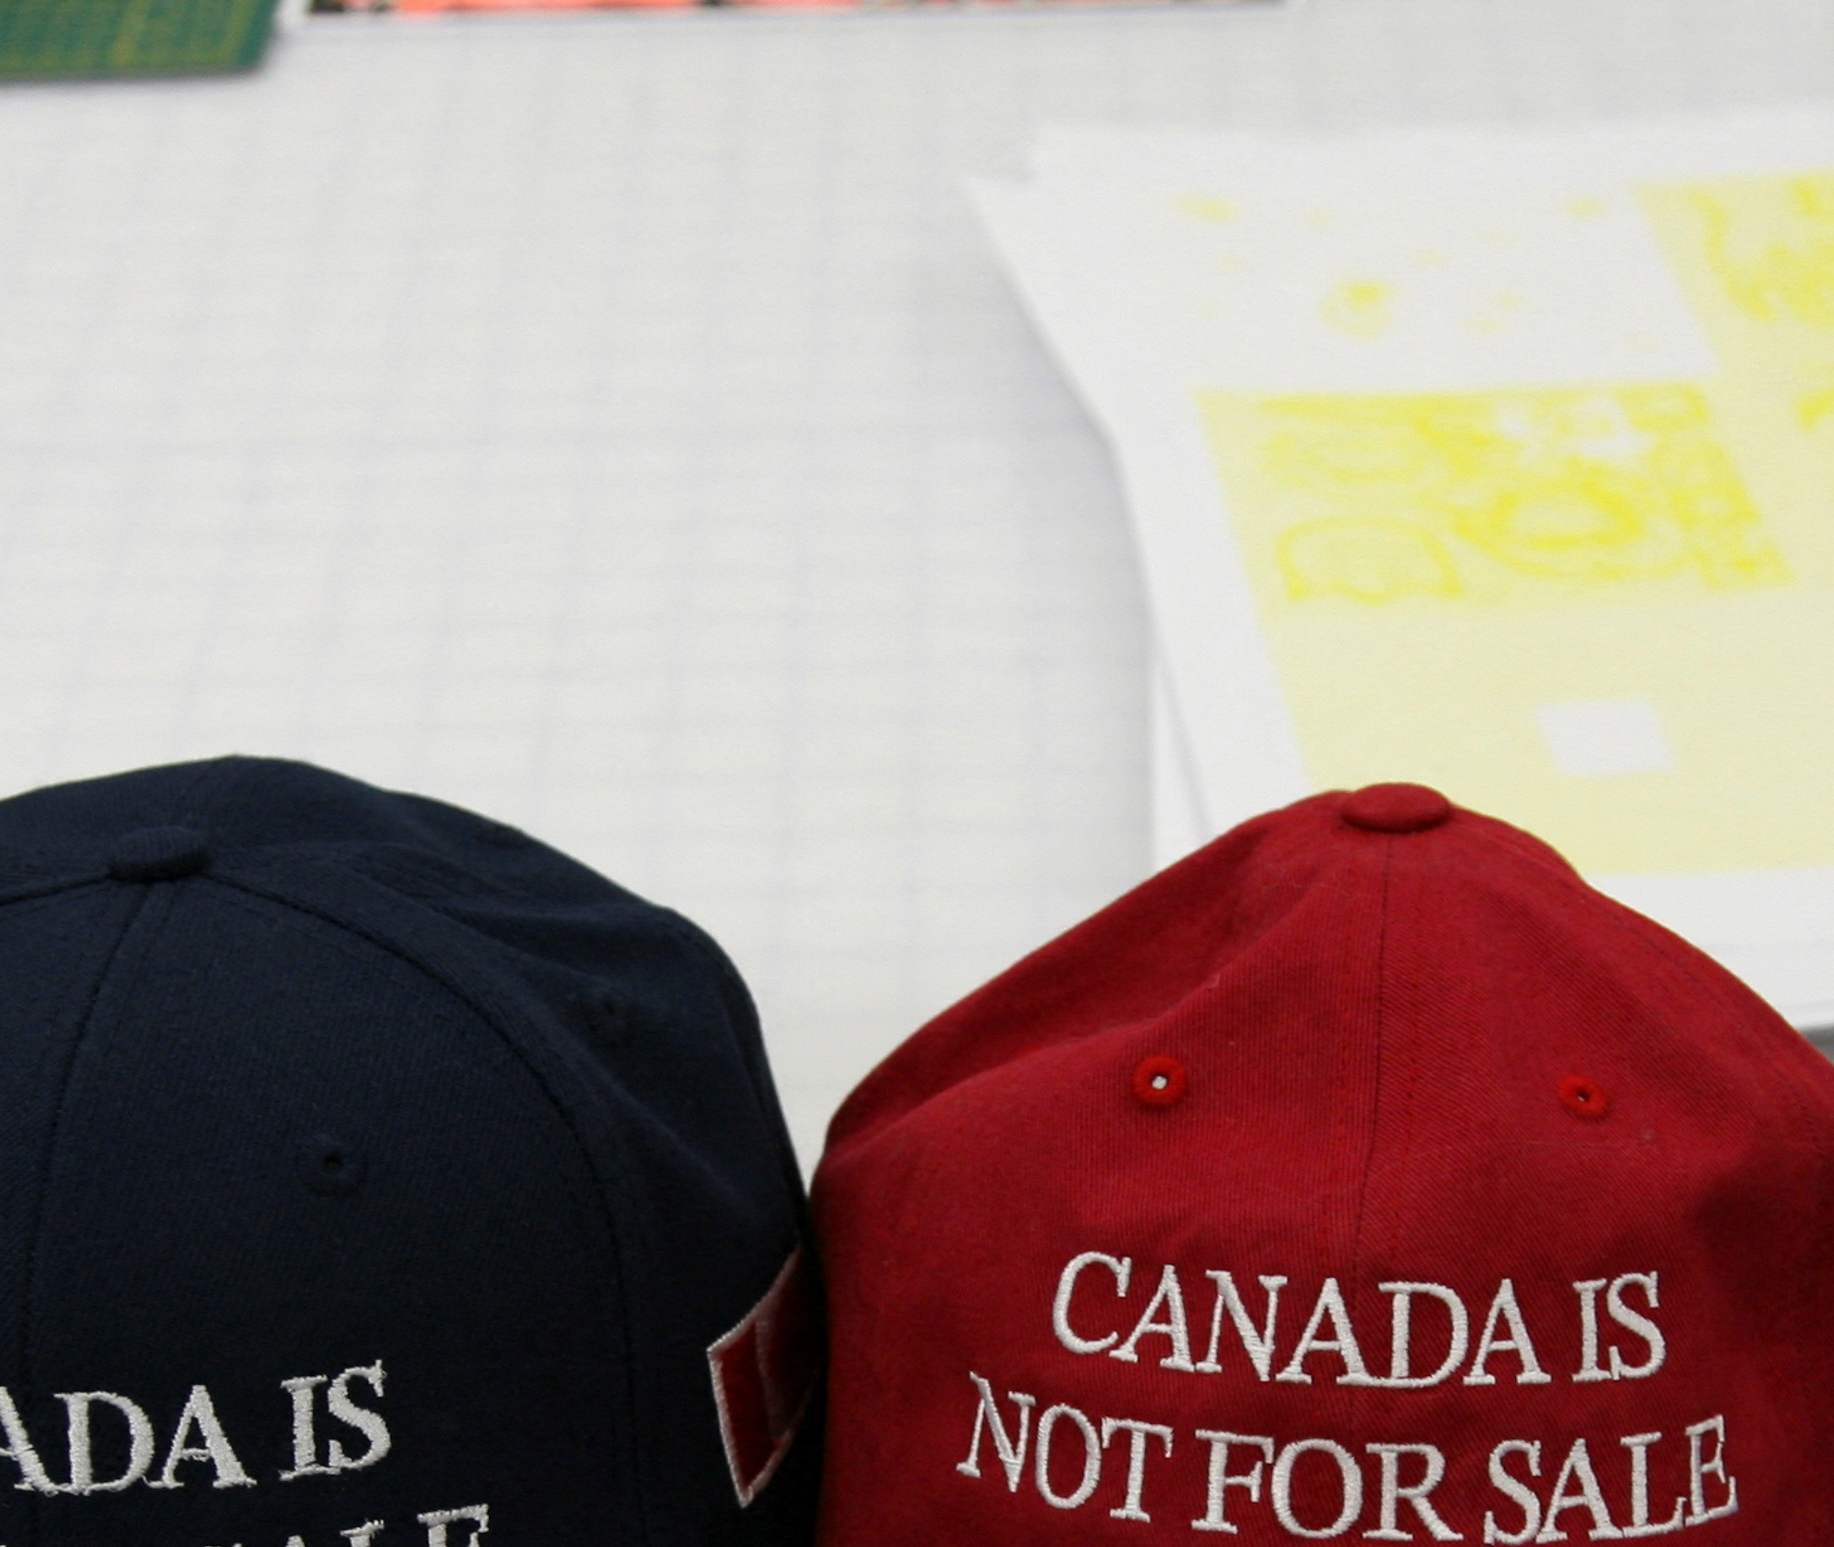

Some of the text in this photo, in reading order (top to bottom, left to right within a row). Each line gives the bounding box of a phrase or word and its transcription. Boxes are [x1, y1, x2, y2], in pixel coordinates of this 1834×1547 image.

[1052, 1250, 1667, 1387] CANADA IS
[280, 1359, 392, 1482] IS
[956, 1371, 1740, 1545] NOT FOR SALE
